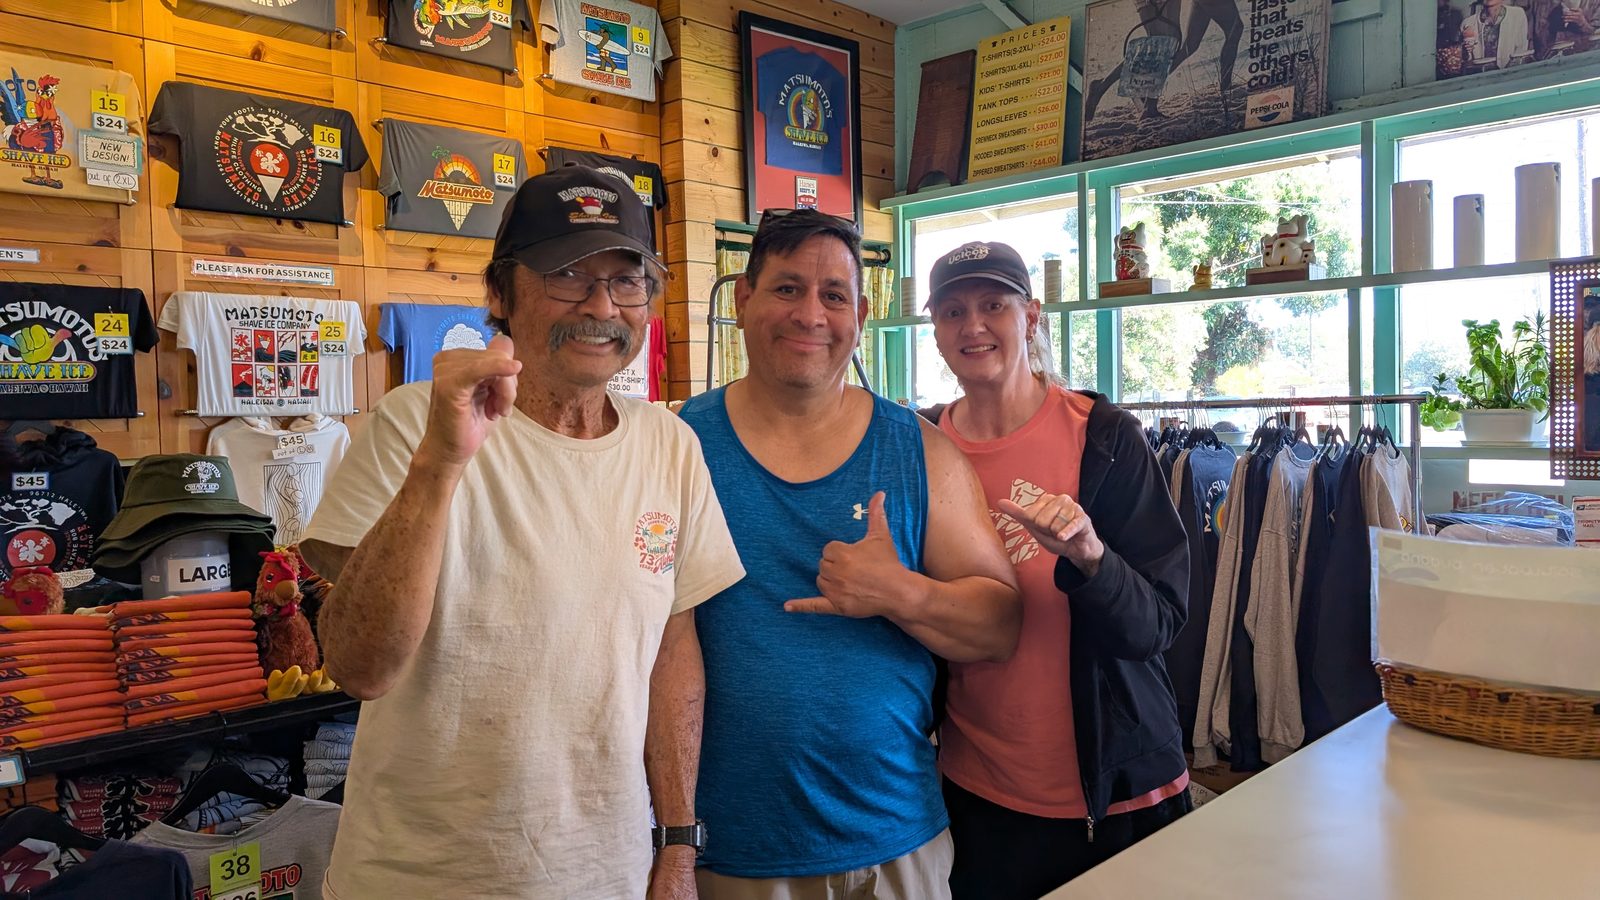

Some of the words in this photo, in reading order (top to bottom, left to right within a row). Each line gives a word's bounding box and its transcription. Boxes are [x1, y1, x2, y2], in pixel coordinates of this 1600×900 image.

[1248, 0, 1296, 13] Tas
[491, 13, 509, 24] $24
[1249, 6, 1288, 27] that
[638, 32, 644, 41] 9
[1001, 28, 1046, 45] PRICES
[1250, 20, 1304, 43] beats
[1041, 32, 1067, 47] $24.00
[635, 45, 649, 54] $24
[1248, 42, 1280, 59] the
[1039, 50, 1064, 63] $27.00
[1247, 64, 1296, 89] cold!
[979, 84, 997, 95] KIDS'
[998, 76, 1031, 90] T-SHIRTS
[779, 74, 833, 118] MATSUMOTO'S
[977, 101, 997, 111] TANK
[999, 96, 1019, 106] TOPS
[1038, 85, 1062, 96] $22.00
[99, 98, 118, 111] 15
[1250, 101, 1290, 115] PEPSI-COLA
[219, 114, 233, 129] YOUR
[233, 106, 255, 116] ROOTS
[267, 107, 288, 119] 96712
[976, 110, 1028, 128] LONGSLEEVES
[1038, 103, 1060, 114] $26.00
[97, 116, 123, 129] $24
[320, 131, 335, 144] 16
[998, 126, 1028, 140] SWEATSHIRTS
[100, 142, 122, 152] NEW
[319, 148, 339, 159] $24
[993, 144, 1026, 157] SWEATSHIRTS
[2, 150, 45, 162] SHAVE
[48, 153, 67, 166] ICE
[92, 151, 130, 163] DESIGN!
[498, 158, 511, 170] 17
[993, 161, 1025, 174] SWEATSHIRTS
[87, 171, 101, 181] out
[103, 173, 112, 184] of
[232, 162, 263, 193] CLOTHING
[282, 183, 301, 196] ALOHA
[298, 163, 309, 183] STATE
[283, 176, 318, 207] SHAVE
[305, 147, 319, 171] ICE
[496, 175, 513, 185] $24
[420, 180, 494, 202] Matsumoto
[638, 180, 650, 191] 18
[557, 186, 618, 204] MATSUMOTO
[640, 195, 650, 203] 24
[196, 263, 234, 273] PLEASE
[235, 266, 254, 275] ASK
[256, 267, 275, 276] FOR
[276, 268, 331, 280] ASSISTANCE
[224, 306, 324, 325] MATSUMOTO
[102, 319, 123, 332] 24
[239, 320, 262, 328] SHAVE
[265, 320, 276, 329] ICE
[277, 320, 311, 330] COMPANY
[325, 326, 341, 337] 25
[101, 339, 128, 350] $24
[324, 344, 345, 353] $24
[60, 364, 90, 379] ICE
[608, 383, 631, 391] $30.00
[280, 435, 304, 447] $45
[15, 476, 45, 487] $45
[1204, 480, 1230, 533] MATSU
[640, 553, 655, 567] 73
[220, 855, 250, 880] 38
